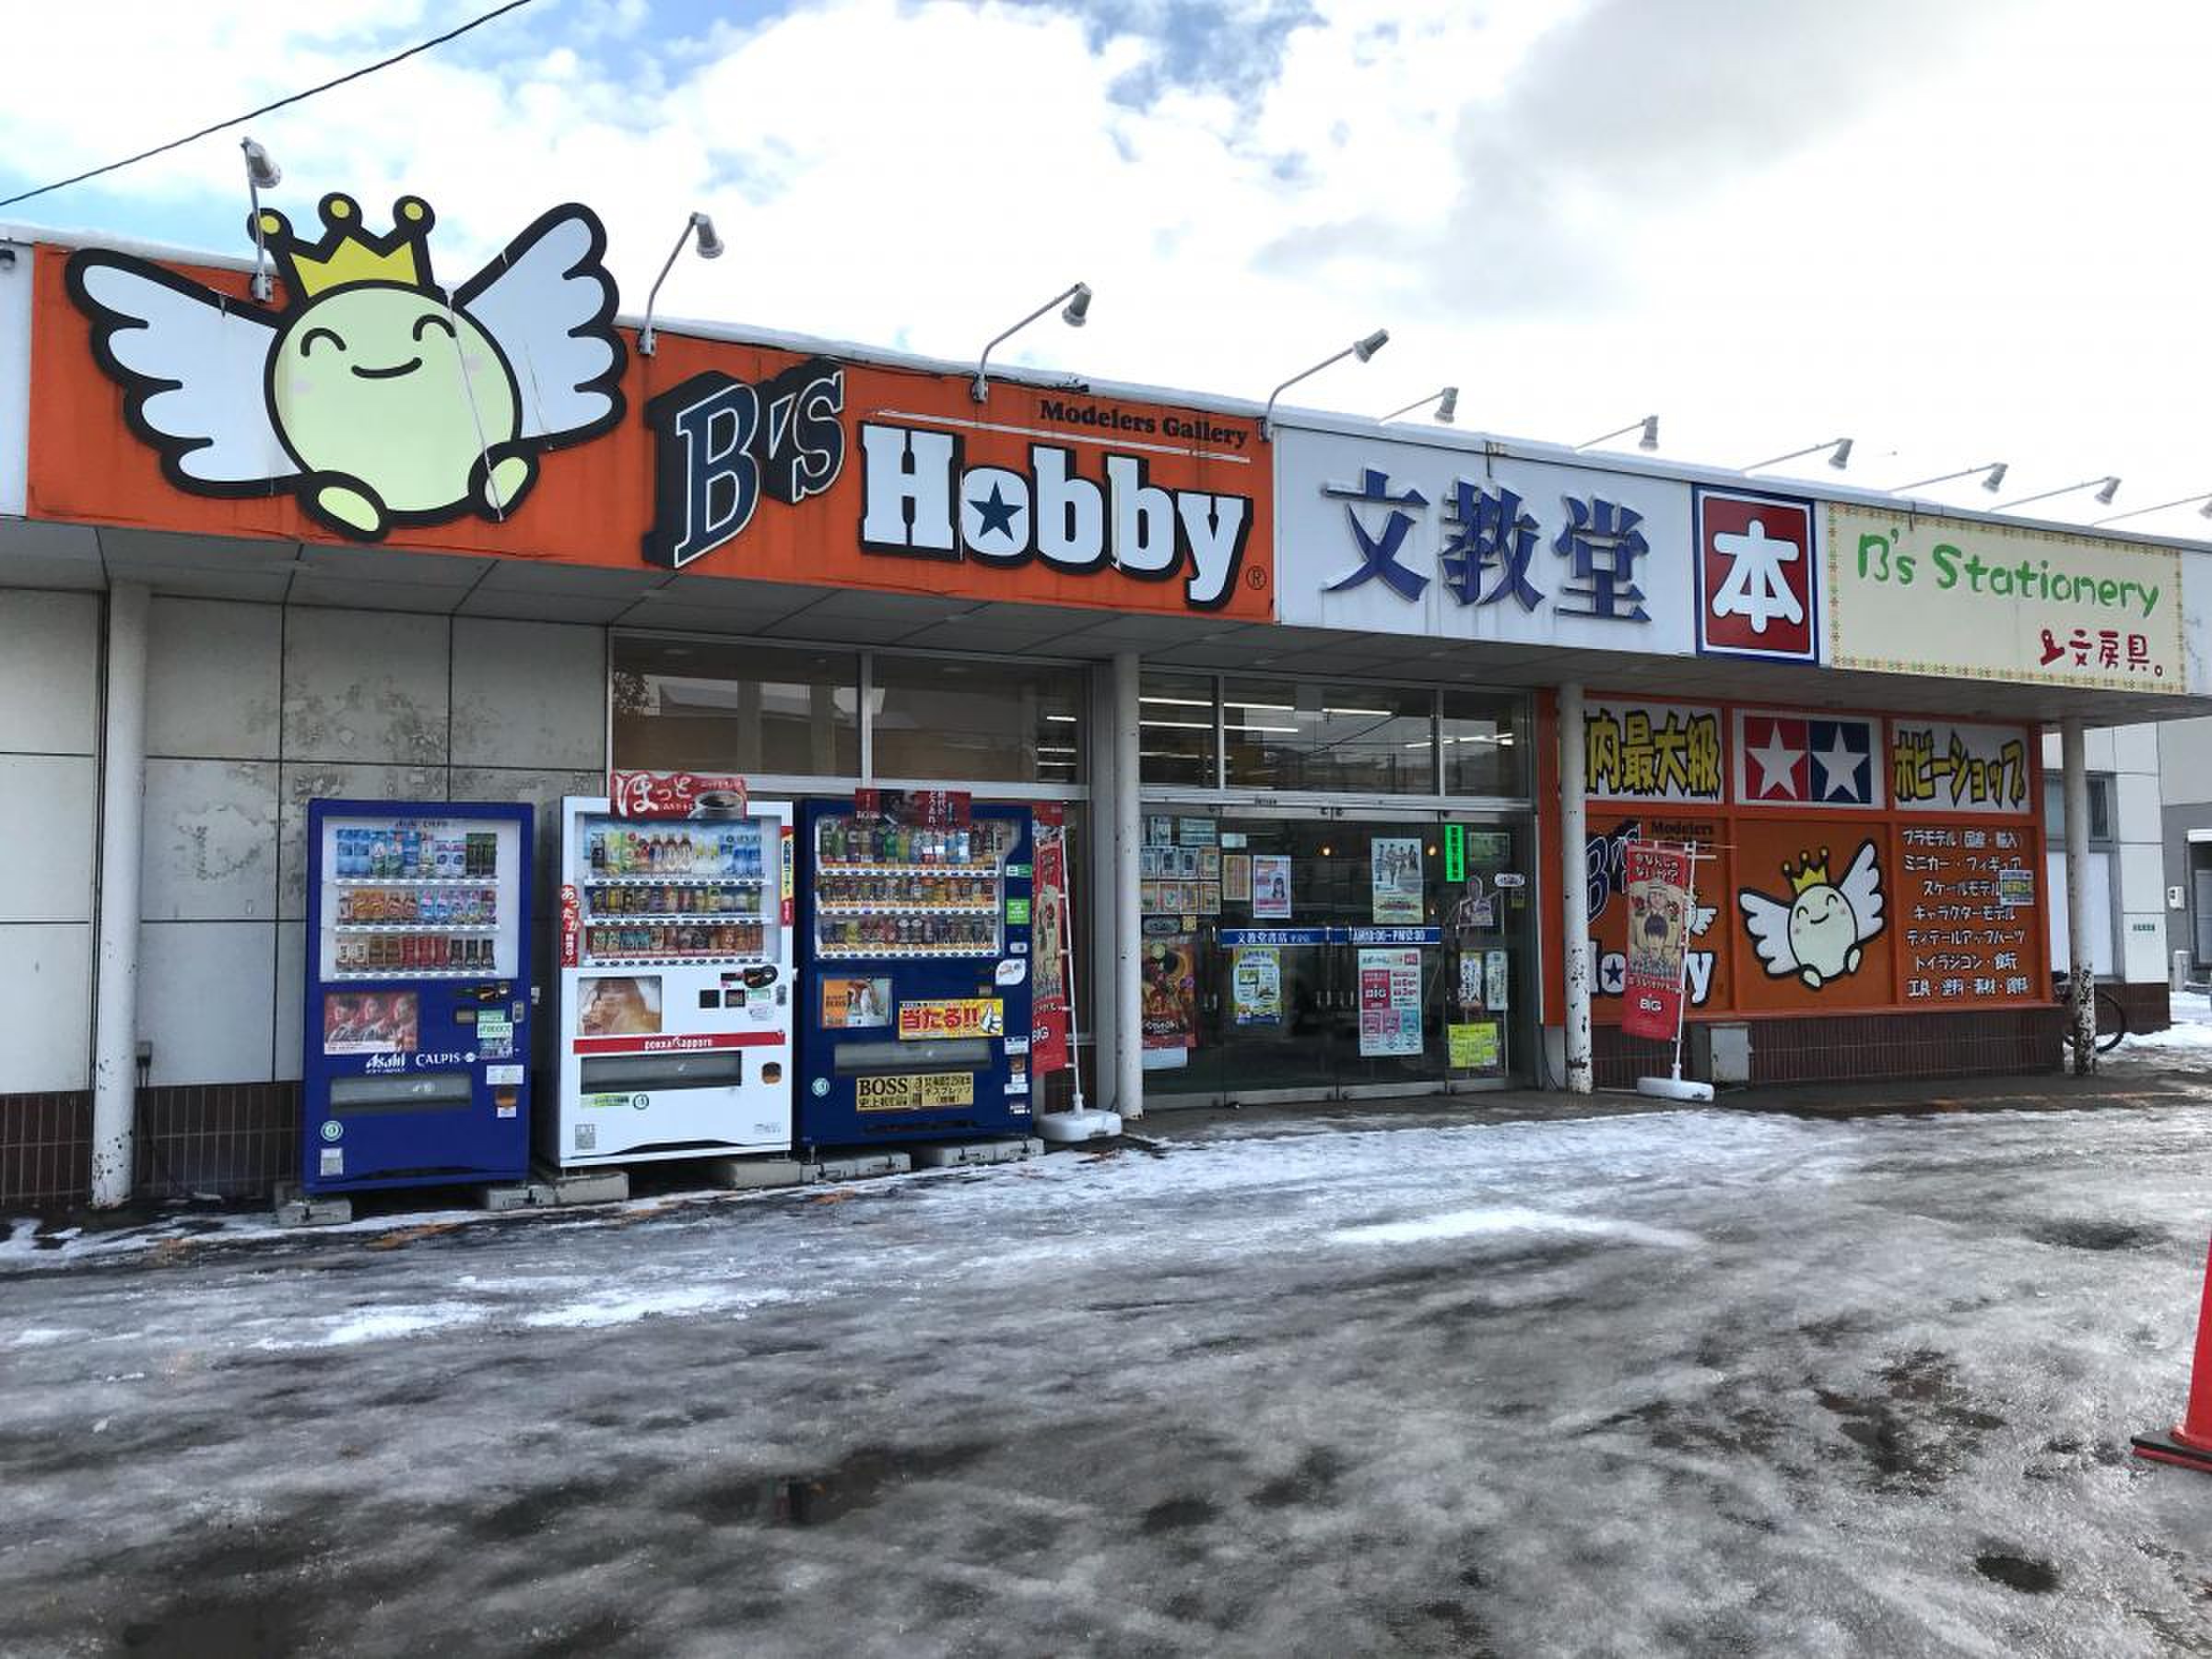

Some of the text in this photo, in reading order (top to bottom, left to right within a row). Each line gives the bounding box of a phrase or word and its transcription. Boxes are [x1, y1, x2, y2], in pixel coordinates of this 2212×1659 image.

[665, 365, 845, 569] B's
[1041, 400, 1248, 449] Modelers Gallery
[862, 422, 1249, 605] Hobby
[1322, 466, 1653, 623] 文教堂
[1712, 519, 1804, 633] 本
[1856, 529, 2159, 618] B's Stationery
[416, 1052, 460, 1066] CALPIS
[858, 1077, 908, 1097] BOSS
